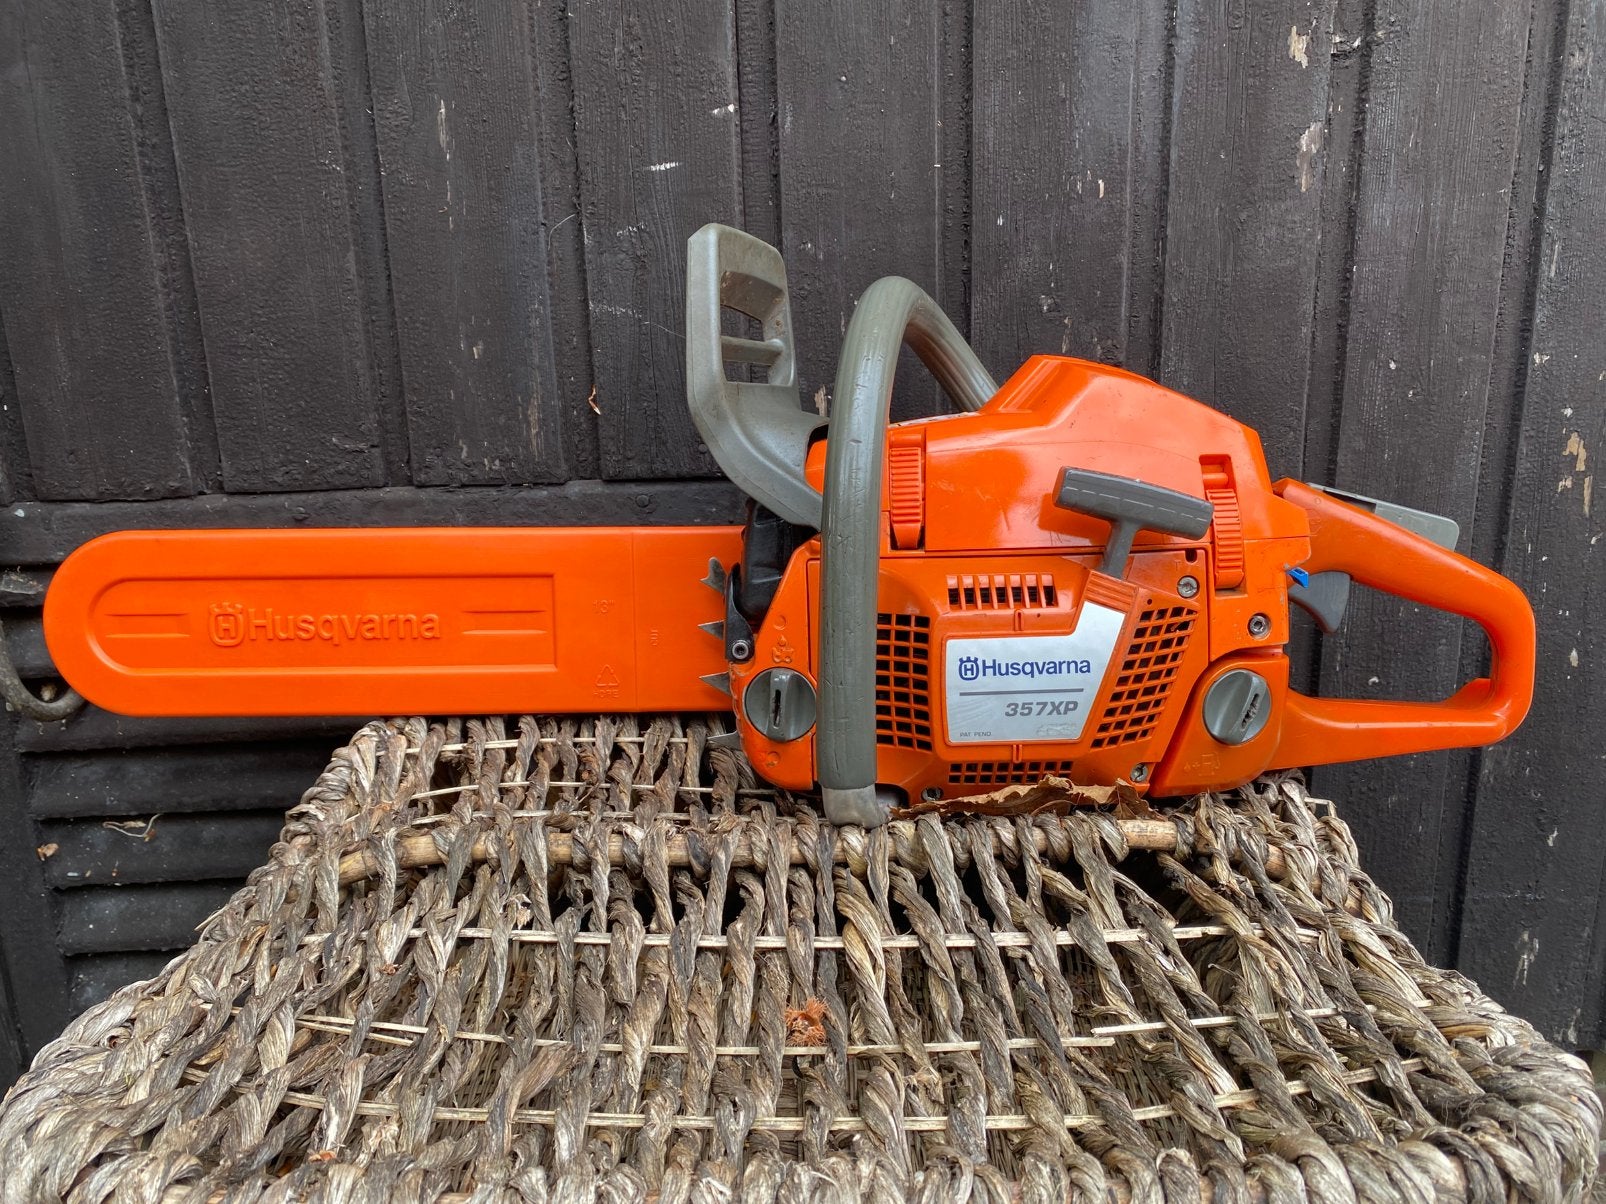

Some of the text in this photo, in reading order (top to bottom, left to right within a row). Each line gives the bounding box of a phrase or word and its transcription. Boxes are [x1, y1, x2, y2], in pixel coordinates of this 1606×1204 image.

[249, 607, 441, 646] Husqvarna
[982, 659, 1091, 678] Husqvarna
[1004, 701, 1079, 717] 357XP
